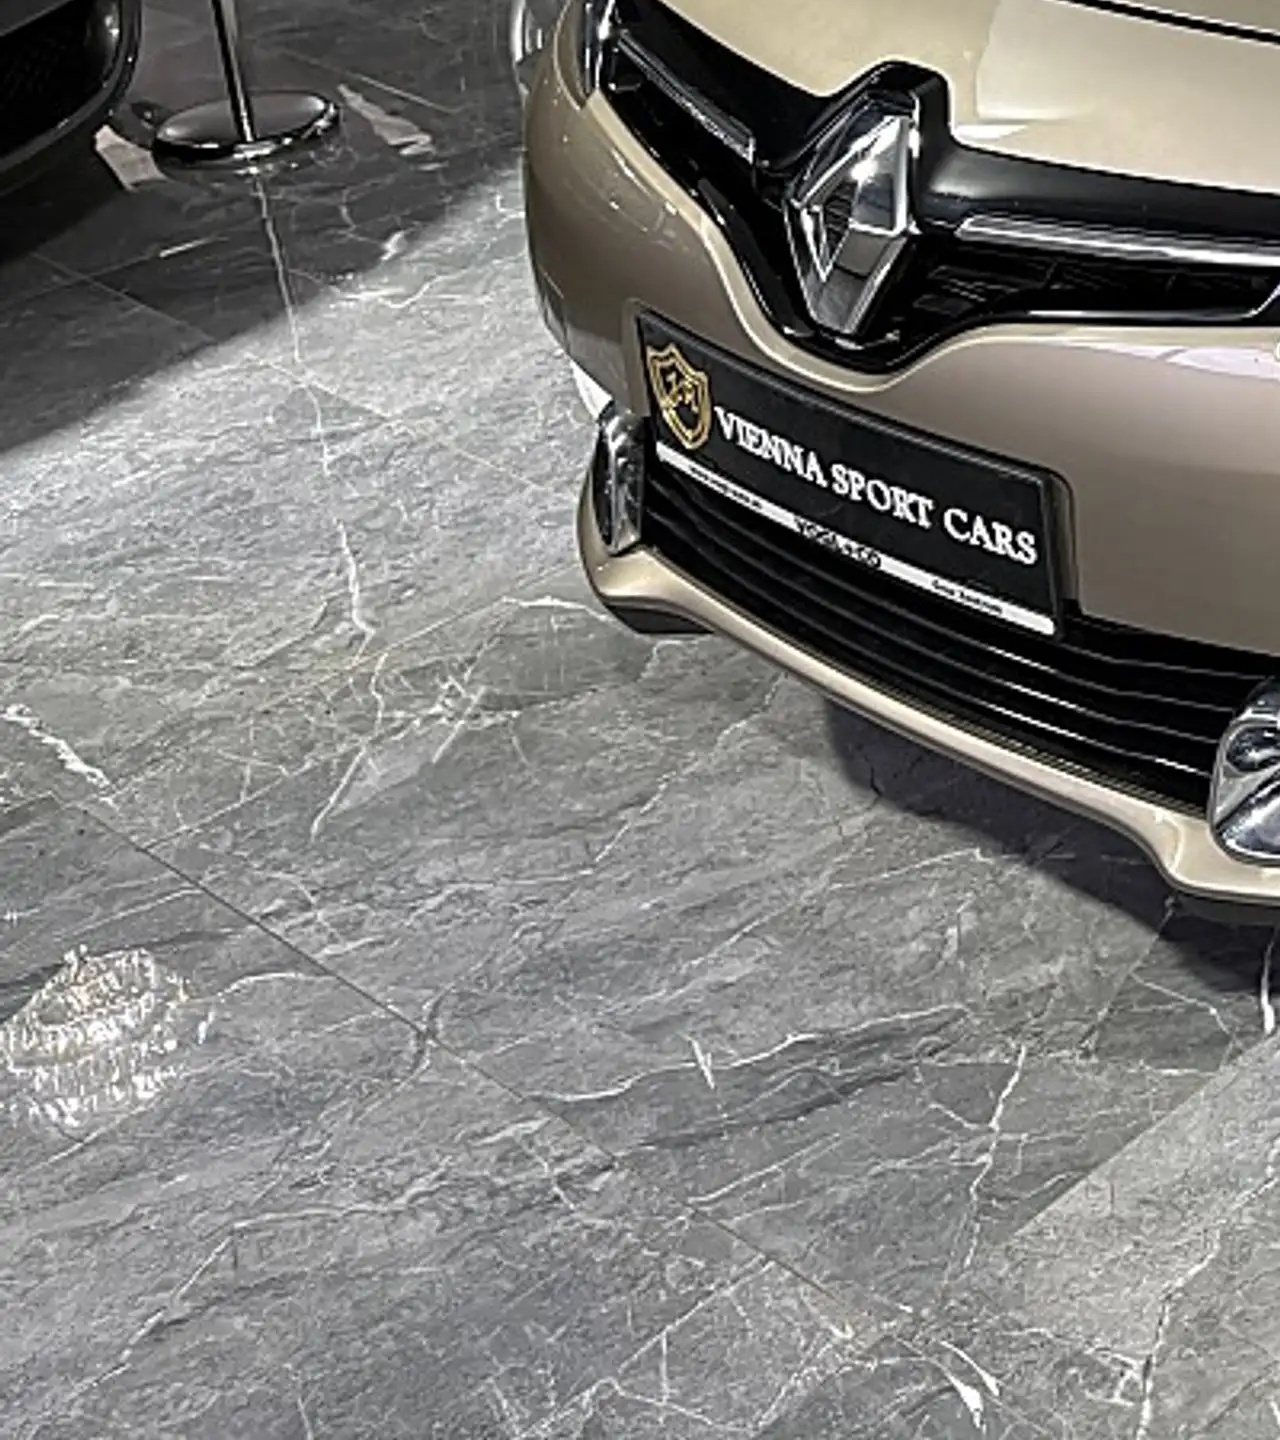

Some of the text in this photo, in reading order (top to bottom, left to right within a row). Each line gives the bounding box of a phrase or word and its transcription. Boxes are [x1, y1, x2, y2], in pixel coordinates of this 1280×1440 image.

[714, 406, 828, 488] VIENNA
[831, 463, 935, 529] SPORT
[943, 508, 1038, 565] CARS
